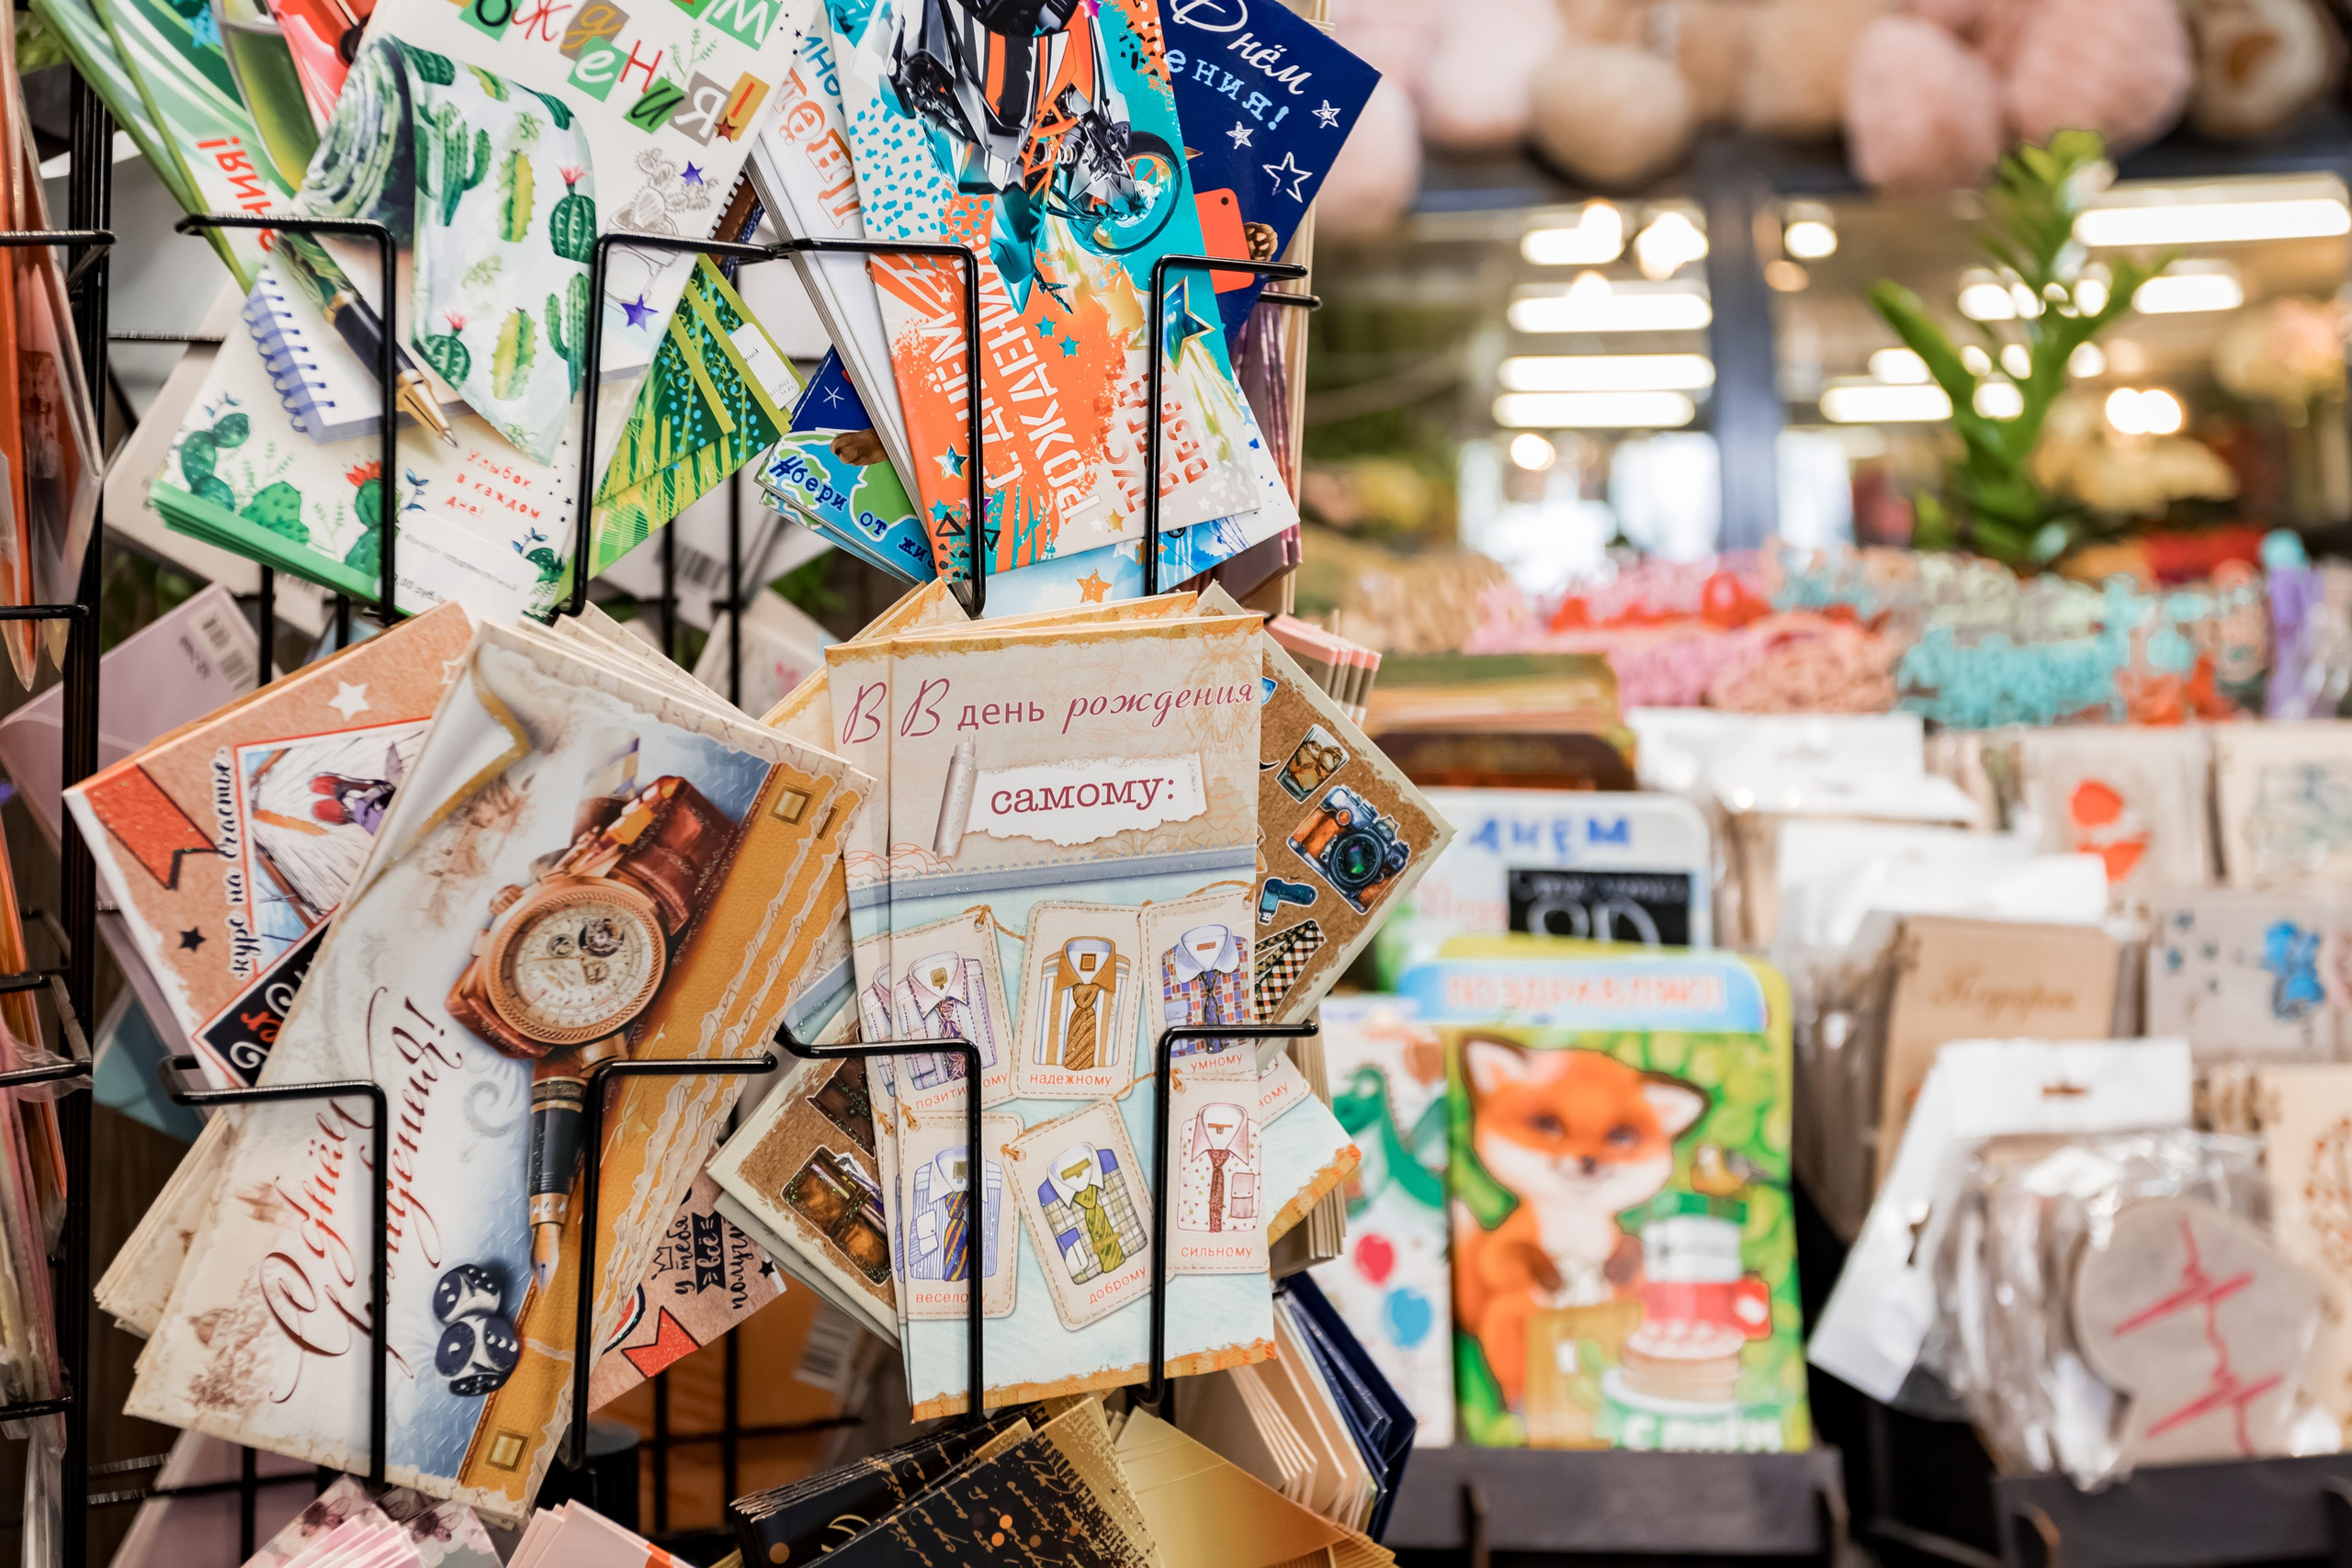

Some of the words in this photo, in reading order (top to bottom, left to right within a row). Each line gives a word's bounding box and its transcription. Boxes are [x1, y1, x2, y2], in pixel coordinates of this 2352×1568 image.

[466, 447, 531, 491] Улыбок
[1092, 396, 1147, 513] ПУСТЬ
[473, 480, 540, 520] каждом
[769, 456, 848, 512] #бери
[860, 513, 888, 536] от
[842, 679, 887, 745] В
[900, 677, 950, 738] В
[957, 700, 1046, 731] день
[1062, 682, 1255, 734] рождения
[990, 777, 1175, 816] самому:
[228, 873, 243, 903] на
[1029, 1073, 1113, 1087] надежному
[1191, 1054, 1243, 1072] умному
[916, 1073, 1008, 1110] позитиому
[667, 1215, 693, 1270] тебя
[696, 1233, 721, 1268] всё
[1181, 1247, 1252, 1259] сильному
[674, 1280, 695, 1295] у
[915, 1293, 987, 1303] веселоу
[1089, 1267, 1146, 1305] доброму
